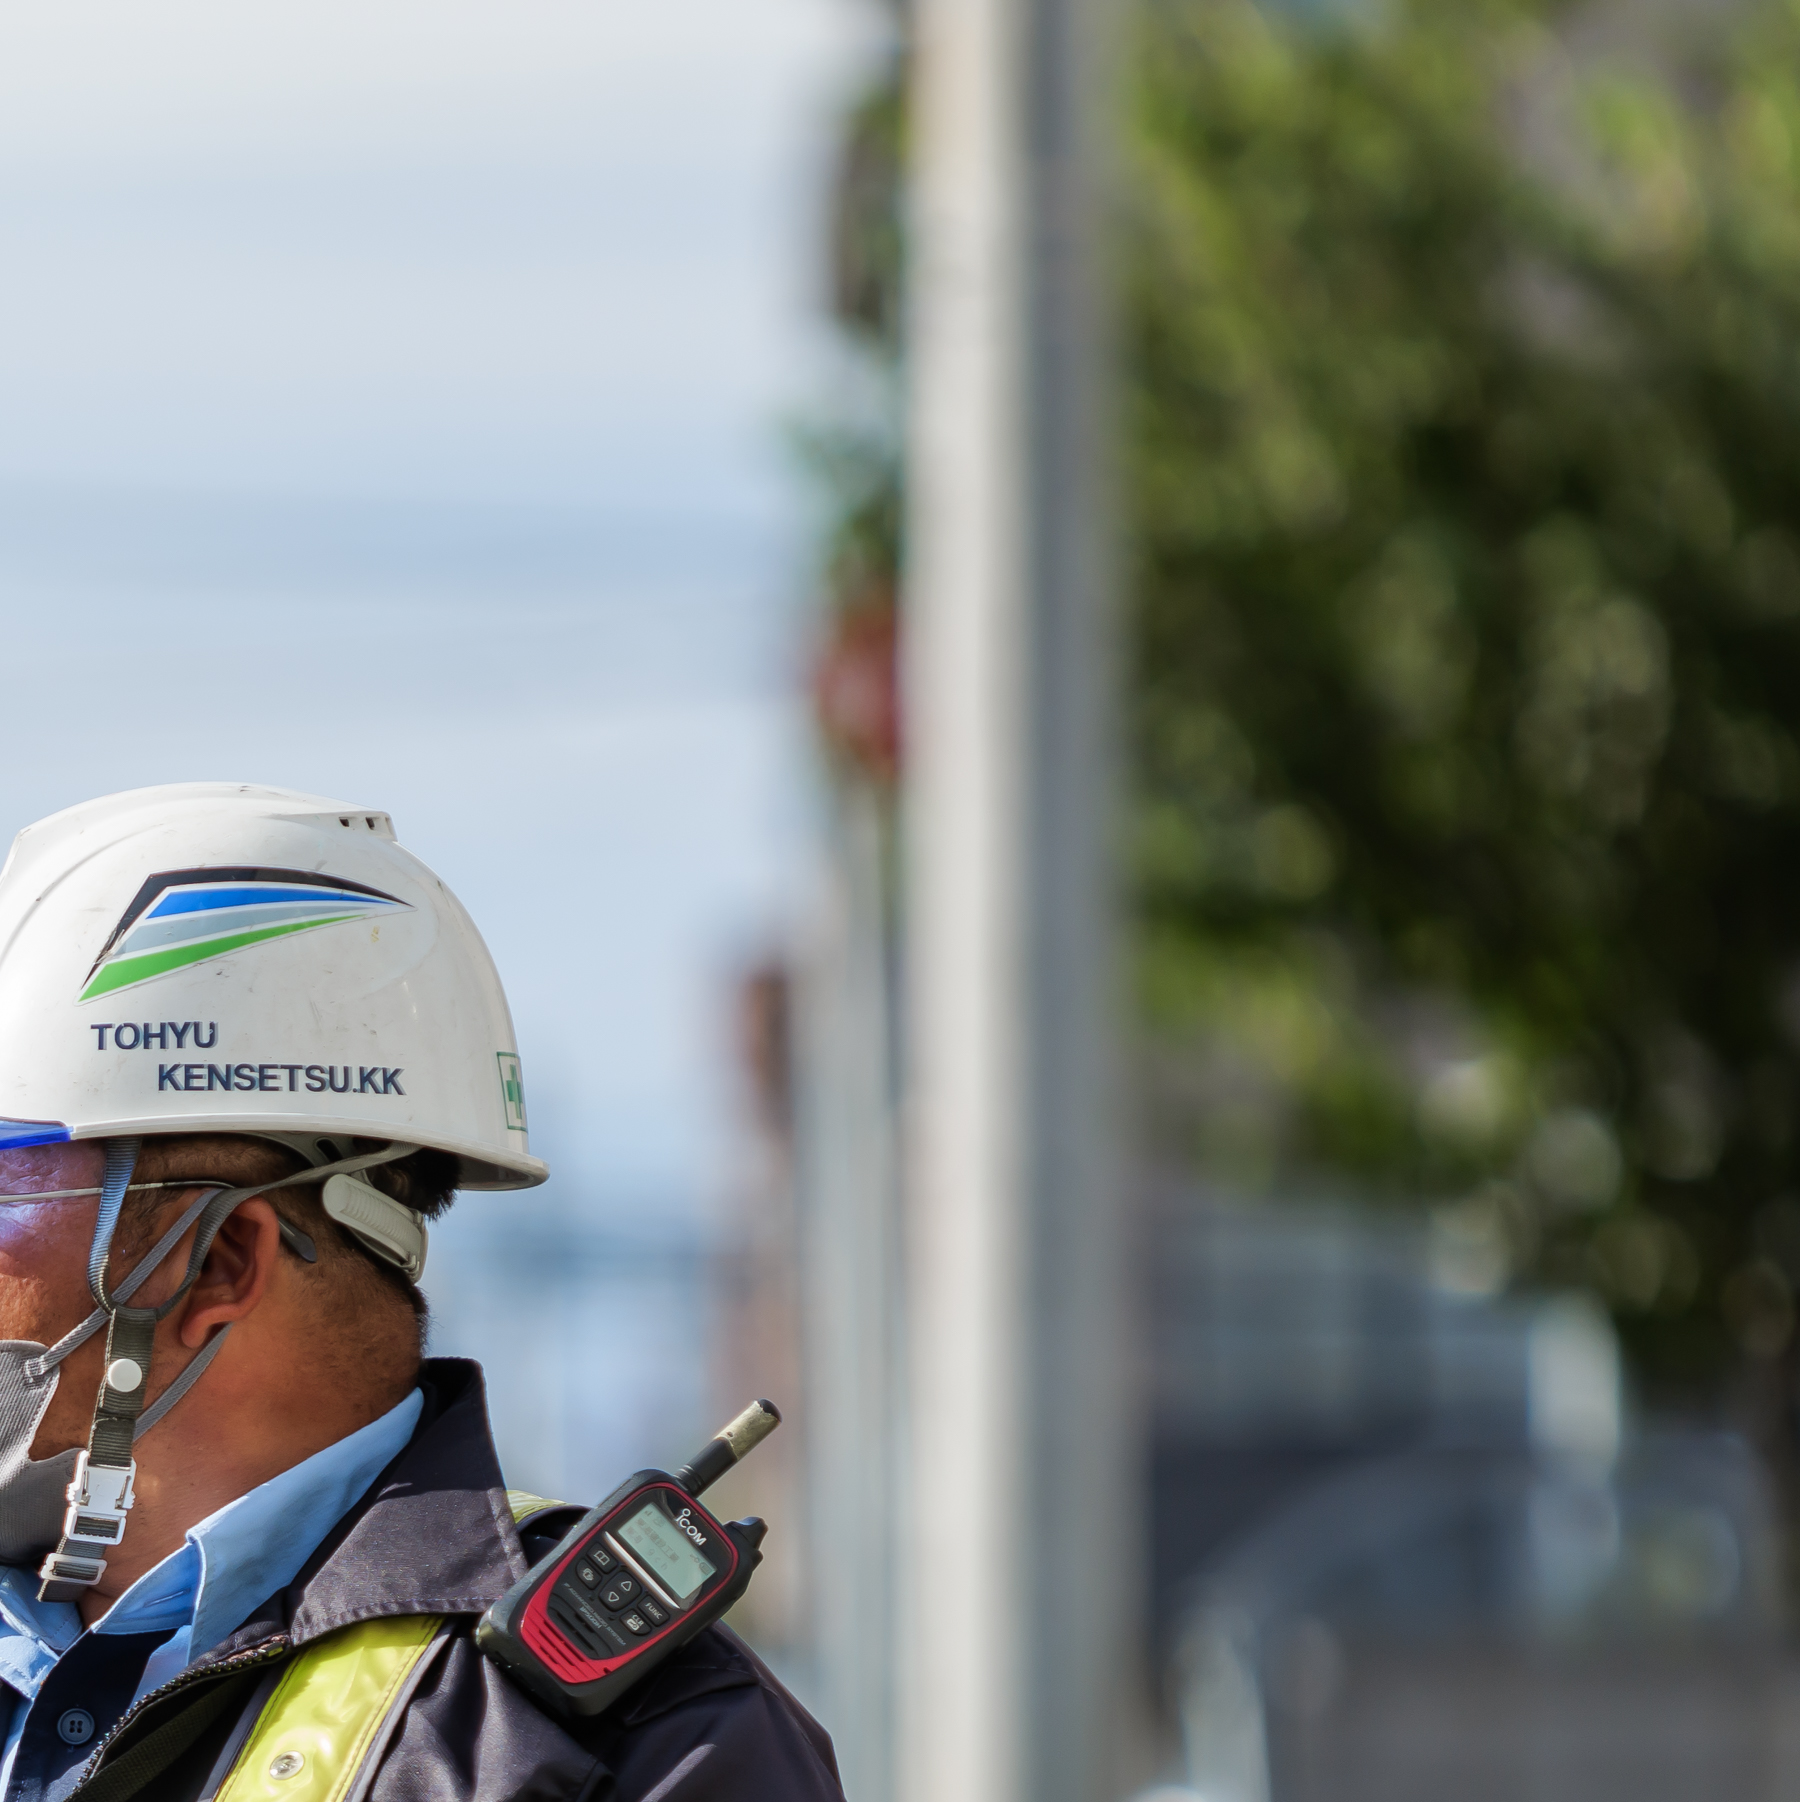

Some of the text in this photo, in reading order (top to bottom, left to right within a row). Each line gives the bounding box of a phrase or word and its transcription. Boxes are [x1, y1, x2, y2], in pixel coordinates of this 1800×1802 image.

[91, 1021, 217, 1051] TOHYU
[158, 1063, 407, 1096] KENSETSU.KK
[632, 1614, 644, 1627] CLR
[645, 1602, 662, 1620] FUNC
